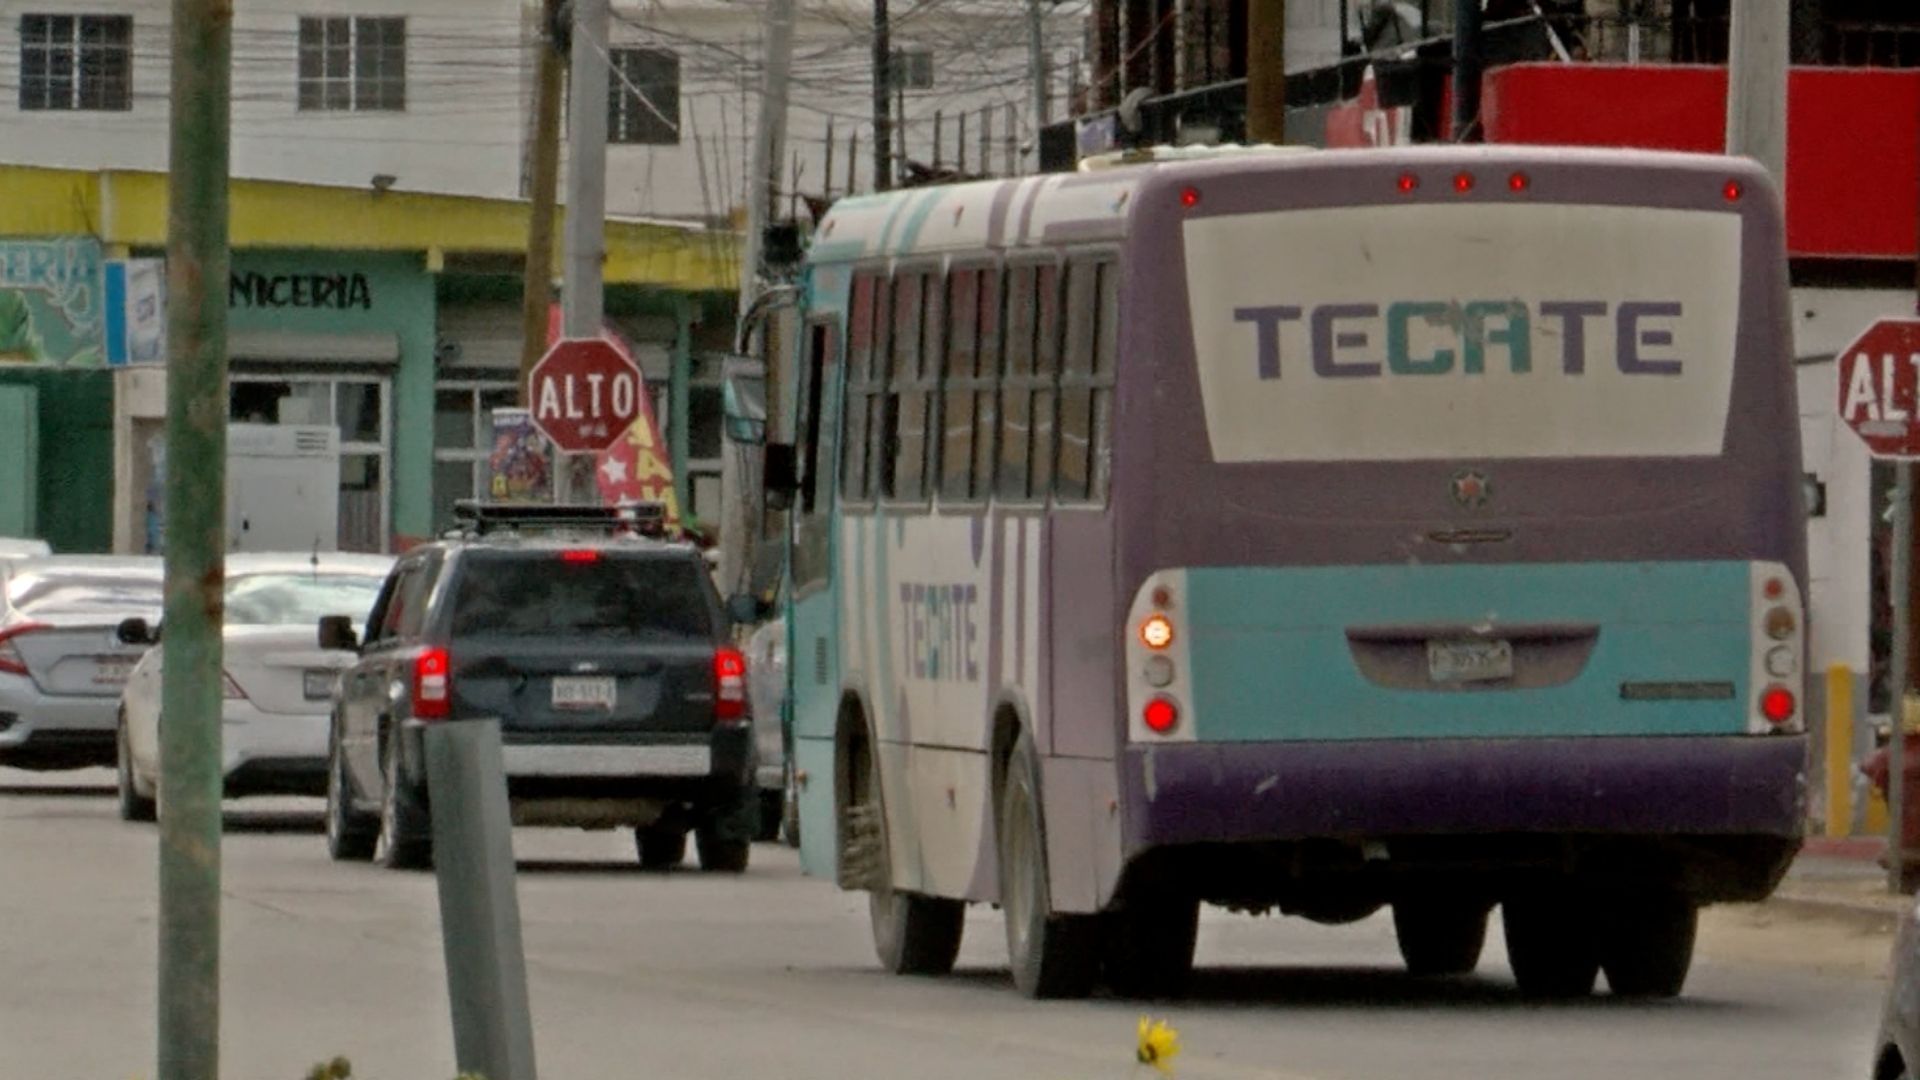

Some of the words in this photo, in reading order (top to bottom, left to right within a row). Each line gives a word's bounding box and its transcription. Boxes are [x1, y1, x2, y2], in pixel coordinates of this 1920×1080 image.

[1233, 301, 1683, 380] TECATE
[538, 373, 634, 419] ALTO
[900, 581, 978, 682] TECATE
